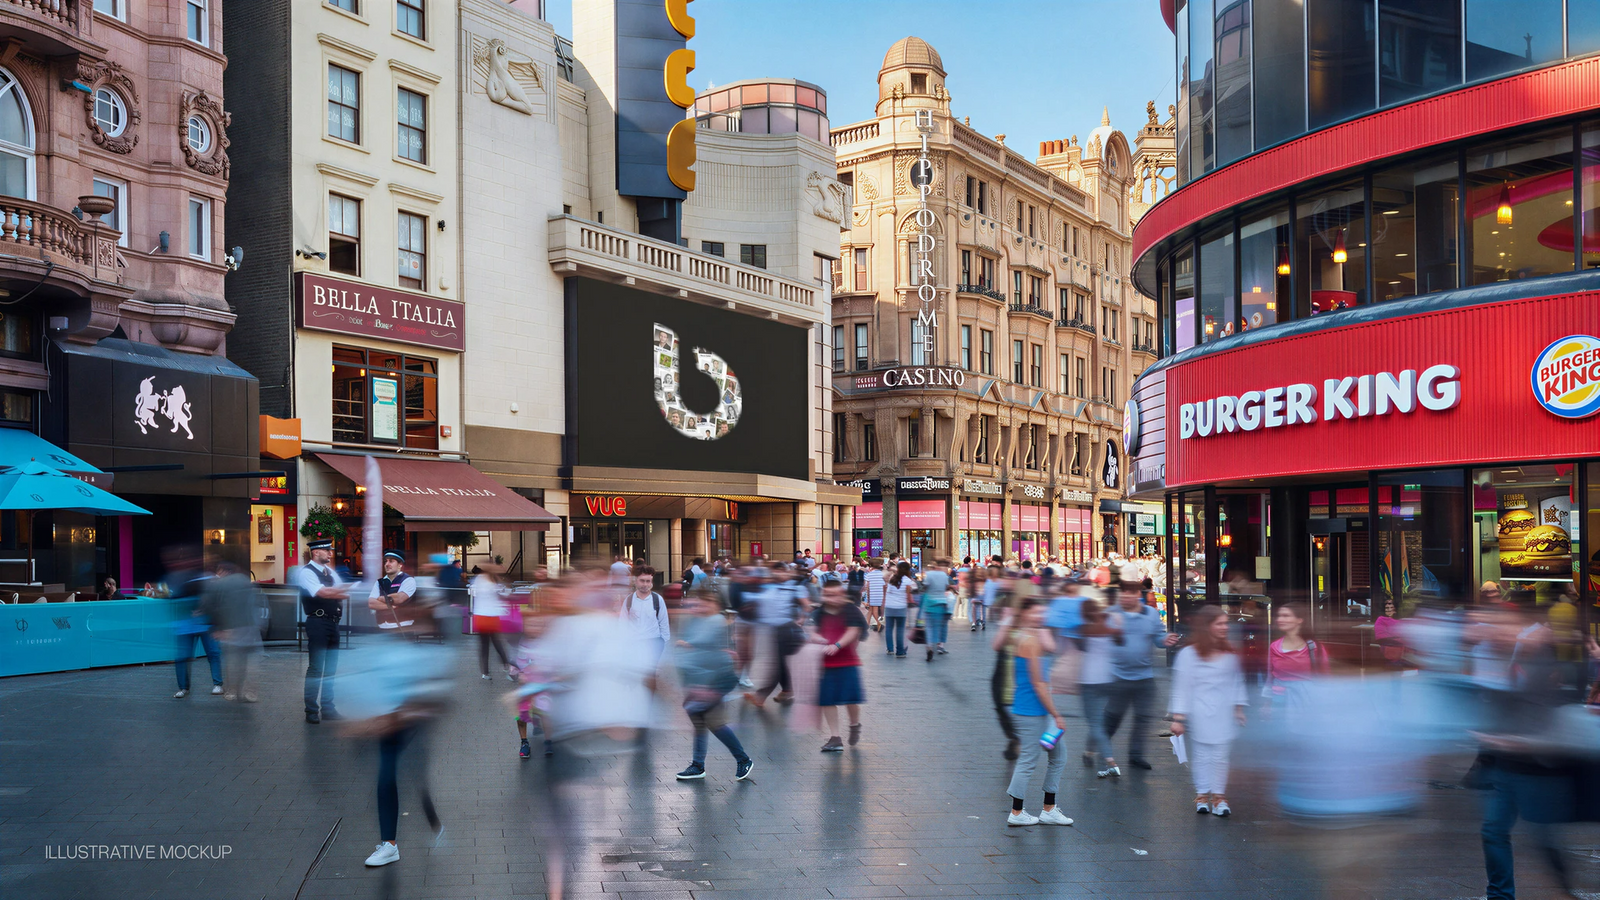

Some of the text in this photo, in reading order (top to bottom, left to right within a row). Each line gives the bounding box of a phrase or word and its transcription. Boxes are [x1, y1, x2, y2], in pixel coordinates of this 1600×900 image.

[914, 109, 938, 352] HIPPODROME
[313, 285, 456, 328] BELLA ITALIA
[883, 368, 965, 387] CASINO
[1540, 348, 1600, 382] BURGER
[1180, 364, 1461, 439] BURGER KING
[382, 484, 497, 497] BELLA ITALIA
